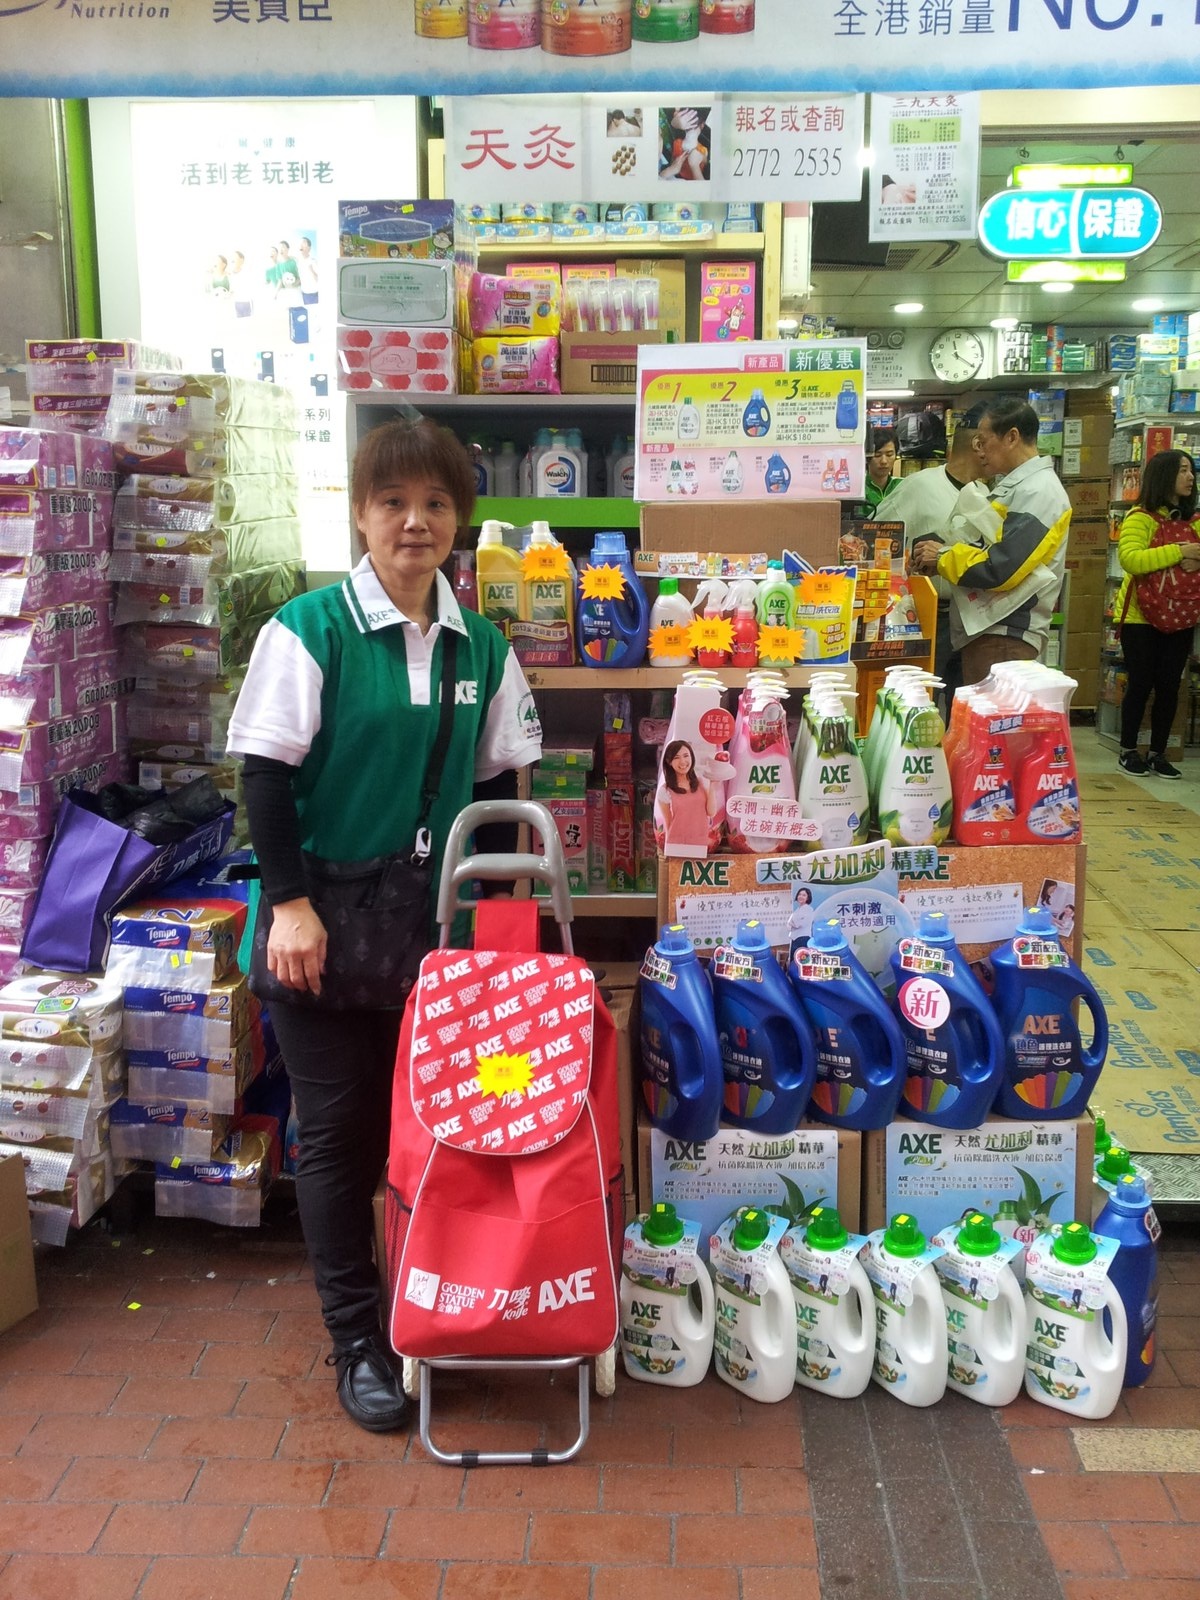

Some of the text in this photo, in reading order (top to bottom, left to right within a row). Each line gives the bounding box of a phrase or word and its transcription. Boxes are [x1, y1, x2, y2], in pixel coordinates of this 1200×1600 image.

[71, 2, 170, 19] Nutrition
[833, 0, 996, 38] 全港銷量
[893, 94, 959, 109] 三九天灸
[735, 104, 845, 134] 報名或查詢
[461, 123, 576, 171] 天灸
[733, 147, 842, 177] 2772 2535
[181, 161, 335, 186] 活到老 玩到老
[341, 203, 369, 217] Tempo
[1083, 198, 1144, 240] 保證
[747, 356, 779, 369] 新產品
[795, 349, 854, 371] 新優惠
[719, 381, 738, 402] 2
[785, 379, 801, 400] 3
[637, 553, 654, 562] AXE
[487, 584, 514, 600] AXE
[535, 583, 562, 599] AXE
[769, 599, 786, 609] AXE
[367, 611, 391, 625] AXE
[819, 764, 851, 784] AXE
[902, 755, 935, 774] AXE
[748, 765, 781, 784] AXE
[973, 774, 1000, 791] AXE
[1036, 773, 1064, 791] AXE
[743, 819, 819, 837] 洗碗新概念
[679, 860, 731, 887] AXE
[836, 901, 882, 916] 不刺激
[146, 926, 177, 940] Tempo
[202, 929, 214, 946] 2
[912, 944, 942, 959] 新配方
[1031, 941, 1059, 953] 新配方
[725, 952, 751, 966] 新配方
[811, 953, 839, 965] 新配方
[442, 957, 473, 983] AXE
[511, 958, 541, 984] AXE
[160, 991, 193, 1004] Tempo
[218, 995, 230, 1012] 2
[563, 994, 593, 1020] AXE
[909, 987, 941, 1019] 新
[424, 995, 455, 1021] AXE
[493, 995, 523, 1021] AXE
[1022, 1014, 1061, 1035] AXE
[164, 1048, 196, 1061] Tempo
[475, 1033, 505, 1057] AXE
[544, 1033, 574, 1060] AXE
[526, 1073, 556, 1100] AXE
[144, 1104, 175, 1117] Tempo
[433, 1115, 464, 1139] AXE
[507, 1112, 538, 1140] AXE
[664, 1140, 707, 1161] AXE
[898, 1133, 942, 1154] AXE
[193, 1165, 221, 1176] Tempo
[441, 1281, 485, 1300] GOLDEN
[537, 1267, 597, 1314] AXE
[438, 1293, 477, 1309] STATUE
[630, 1300, 661, 1321] AXE
[716, 1298, 738, 1319] AXE
[502, 1305, 529, 1321] Knife
[1034, 1316, 1067, 1343] AXE
